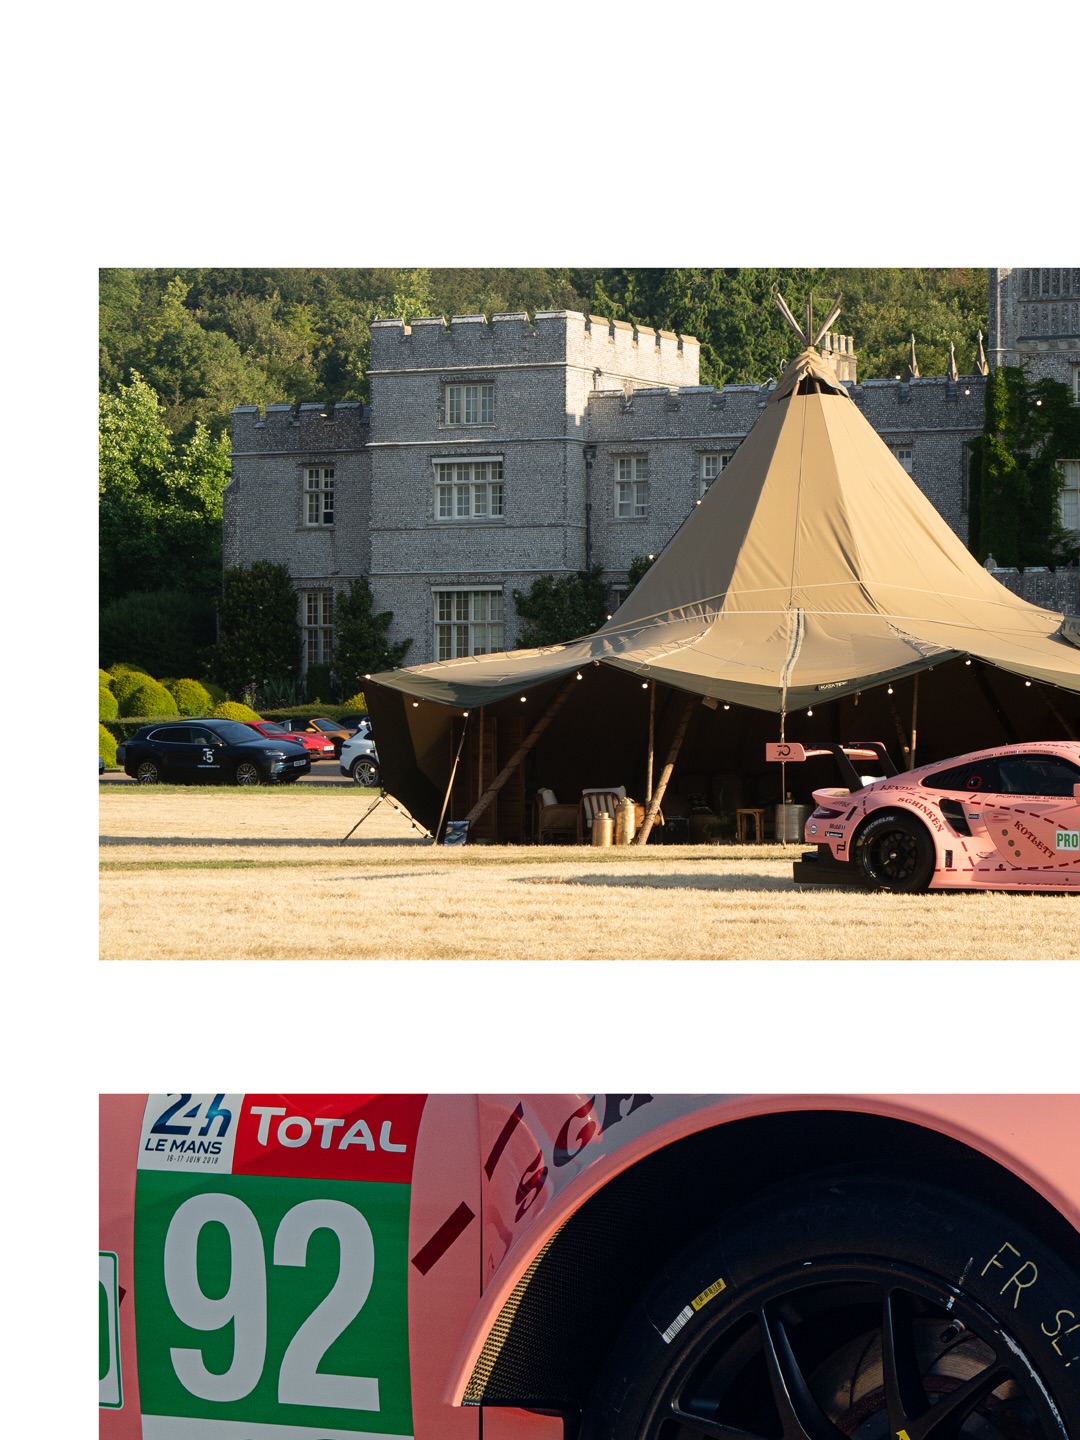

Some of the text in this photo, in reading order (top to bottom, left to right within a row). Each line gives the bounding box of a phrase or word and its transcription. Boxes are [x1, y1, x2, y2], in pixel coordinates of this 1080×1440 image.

[1014, 821, 1056, 859] KOTLETT
[1056, 833, 1079, 847] PRO
[150, 1094, 232, 1137] 24h
[250, 1106, 407, 1153] TOTAL
[145, 1138, 222, 1155] LE MANS
[166, 1155, 219, 1165] 16-17 JUIN 2018
[981, 1242, 1038, 1309] FR
[164, 1192, 380, 1412] 92
